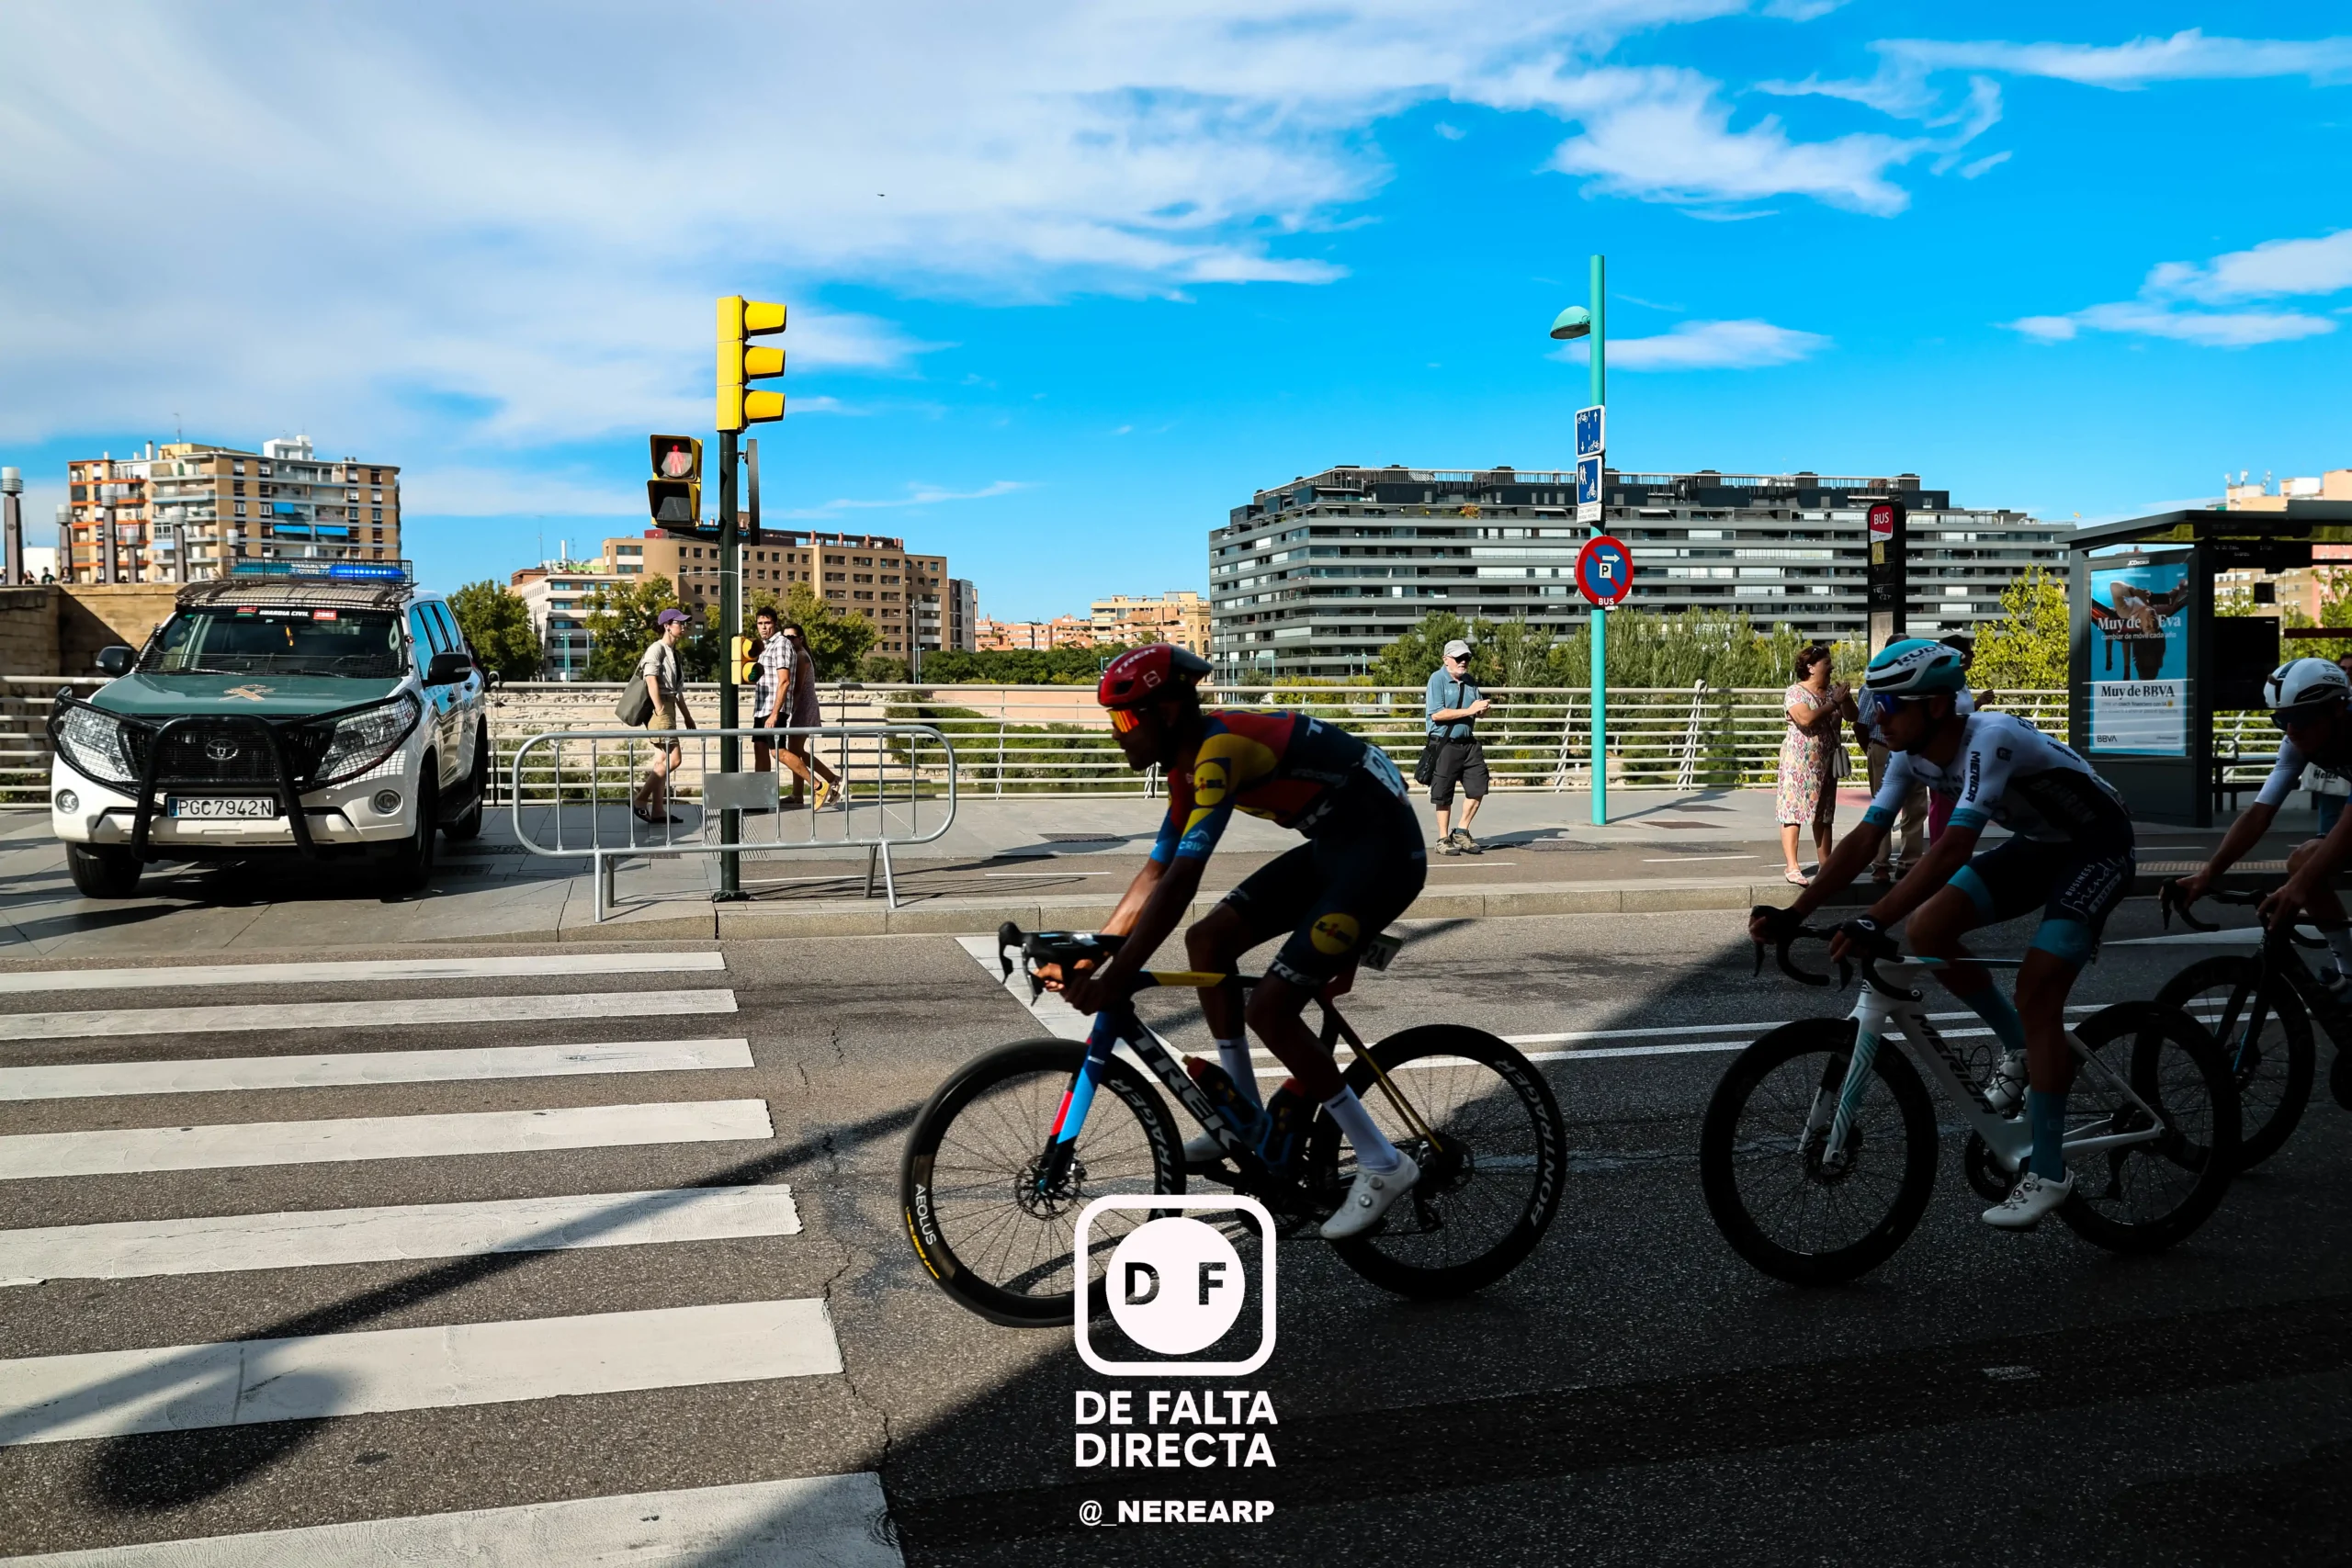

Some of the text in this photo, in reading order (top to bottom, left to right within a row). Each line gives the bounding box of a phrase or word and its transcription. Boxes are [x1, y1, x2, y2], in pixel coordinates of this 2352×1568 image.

[1873, 513, 1889, 525] BUS
[1601, 566, 1610, 576] P
[1598, 597, 1614, 605] BUS
[2098, 615, 2181, 632] Muy de Eva
[2101, 684, 2175, 700] Muy de BBVA
[1965, 751, 1981, 803] MERIDA
[178, 800, 272, 816] PGC7942N
[2064, 863, 2096, 897] BUSINESS
[1366, 944, 1386, 968] 24
[1910, 1014, 1999, 1114] MERIDA
[1133, 1022, 1242, 1151] TREK
[1494, 1058, 1556, 1226] BONTRAGER
[915, 1183, 937, 1245] AEOLUS
